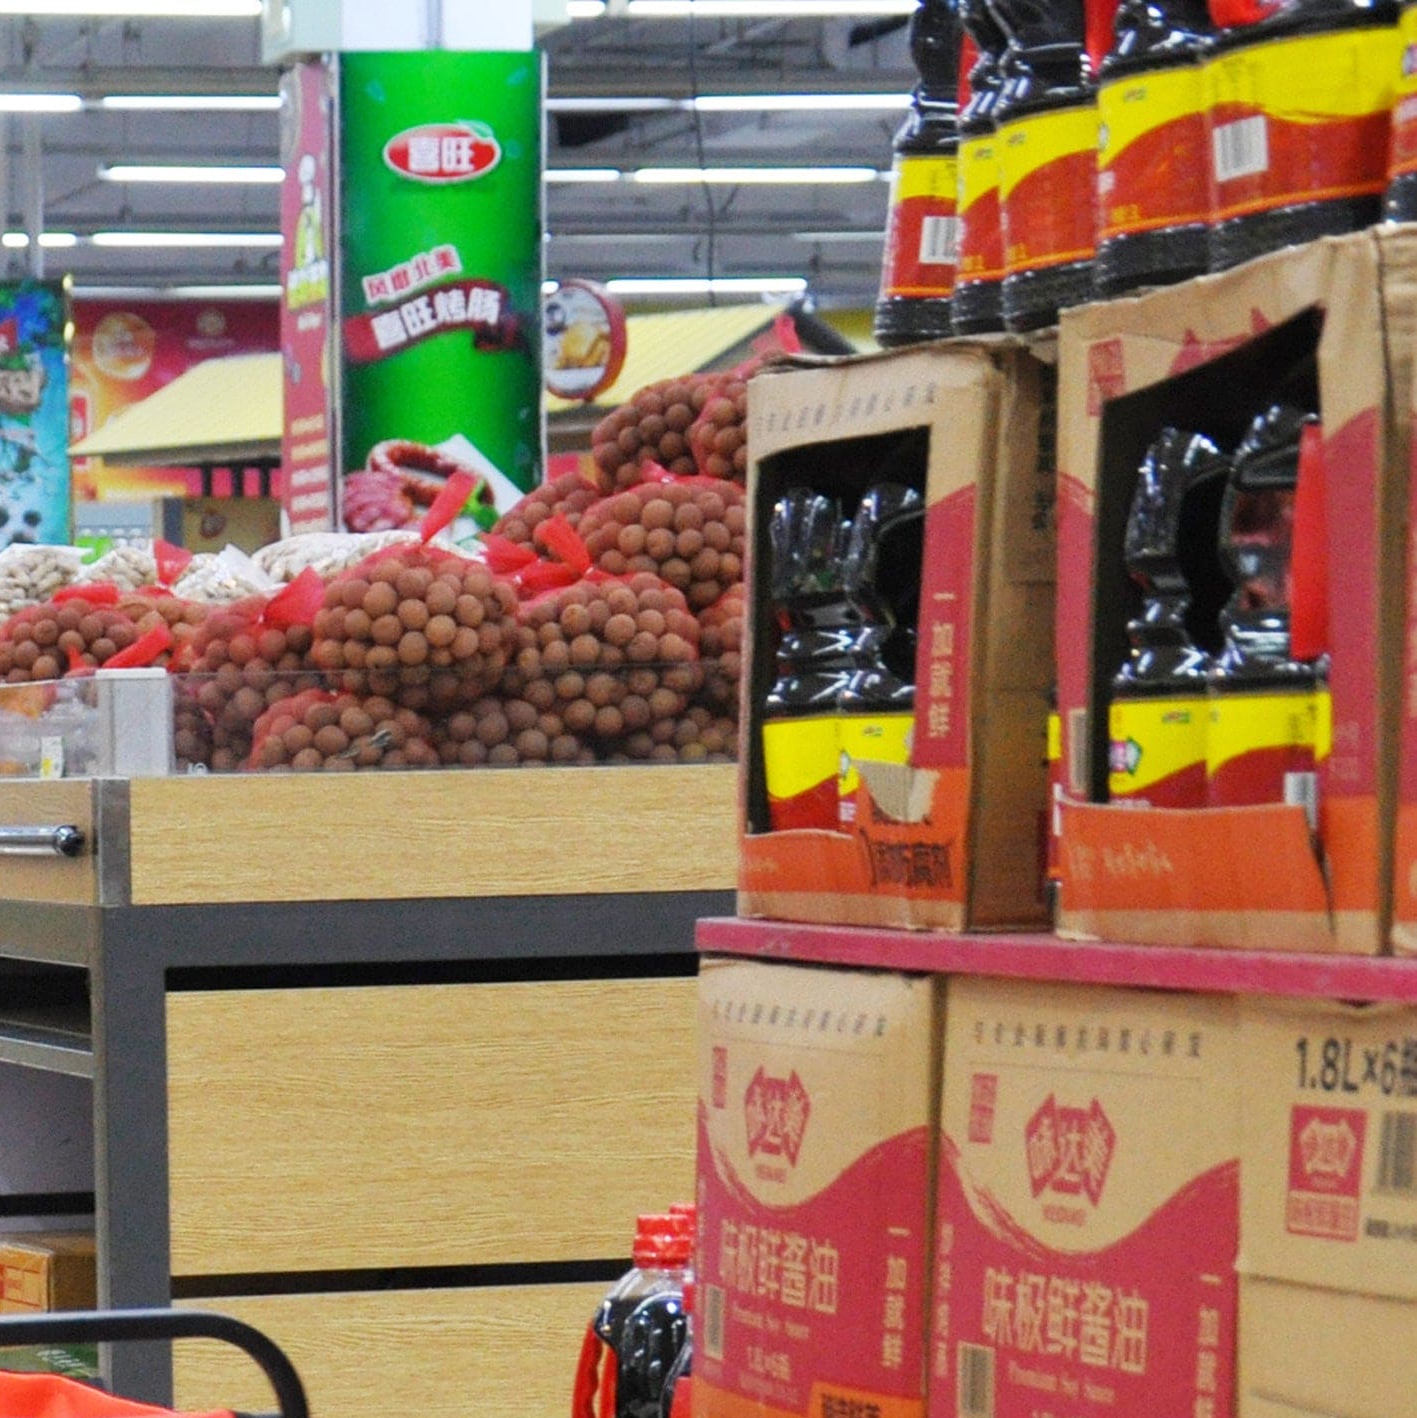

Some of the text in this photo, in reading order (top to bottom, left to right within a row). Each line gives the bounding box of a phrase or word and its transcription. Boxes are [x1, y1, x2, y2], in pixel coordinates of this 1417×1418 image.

[719, 1218, 840, 1316] 味极鲜酱油
[982, 1265, 1149, 1377] 味极鲜酱油
